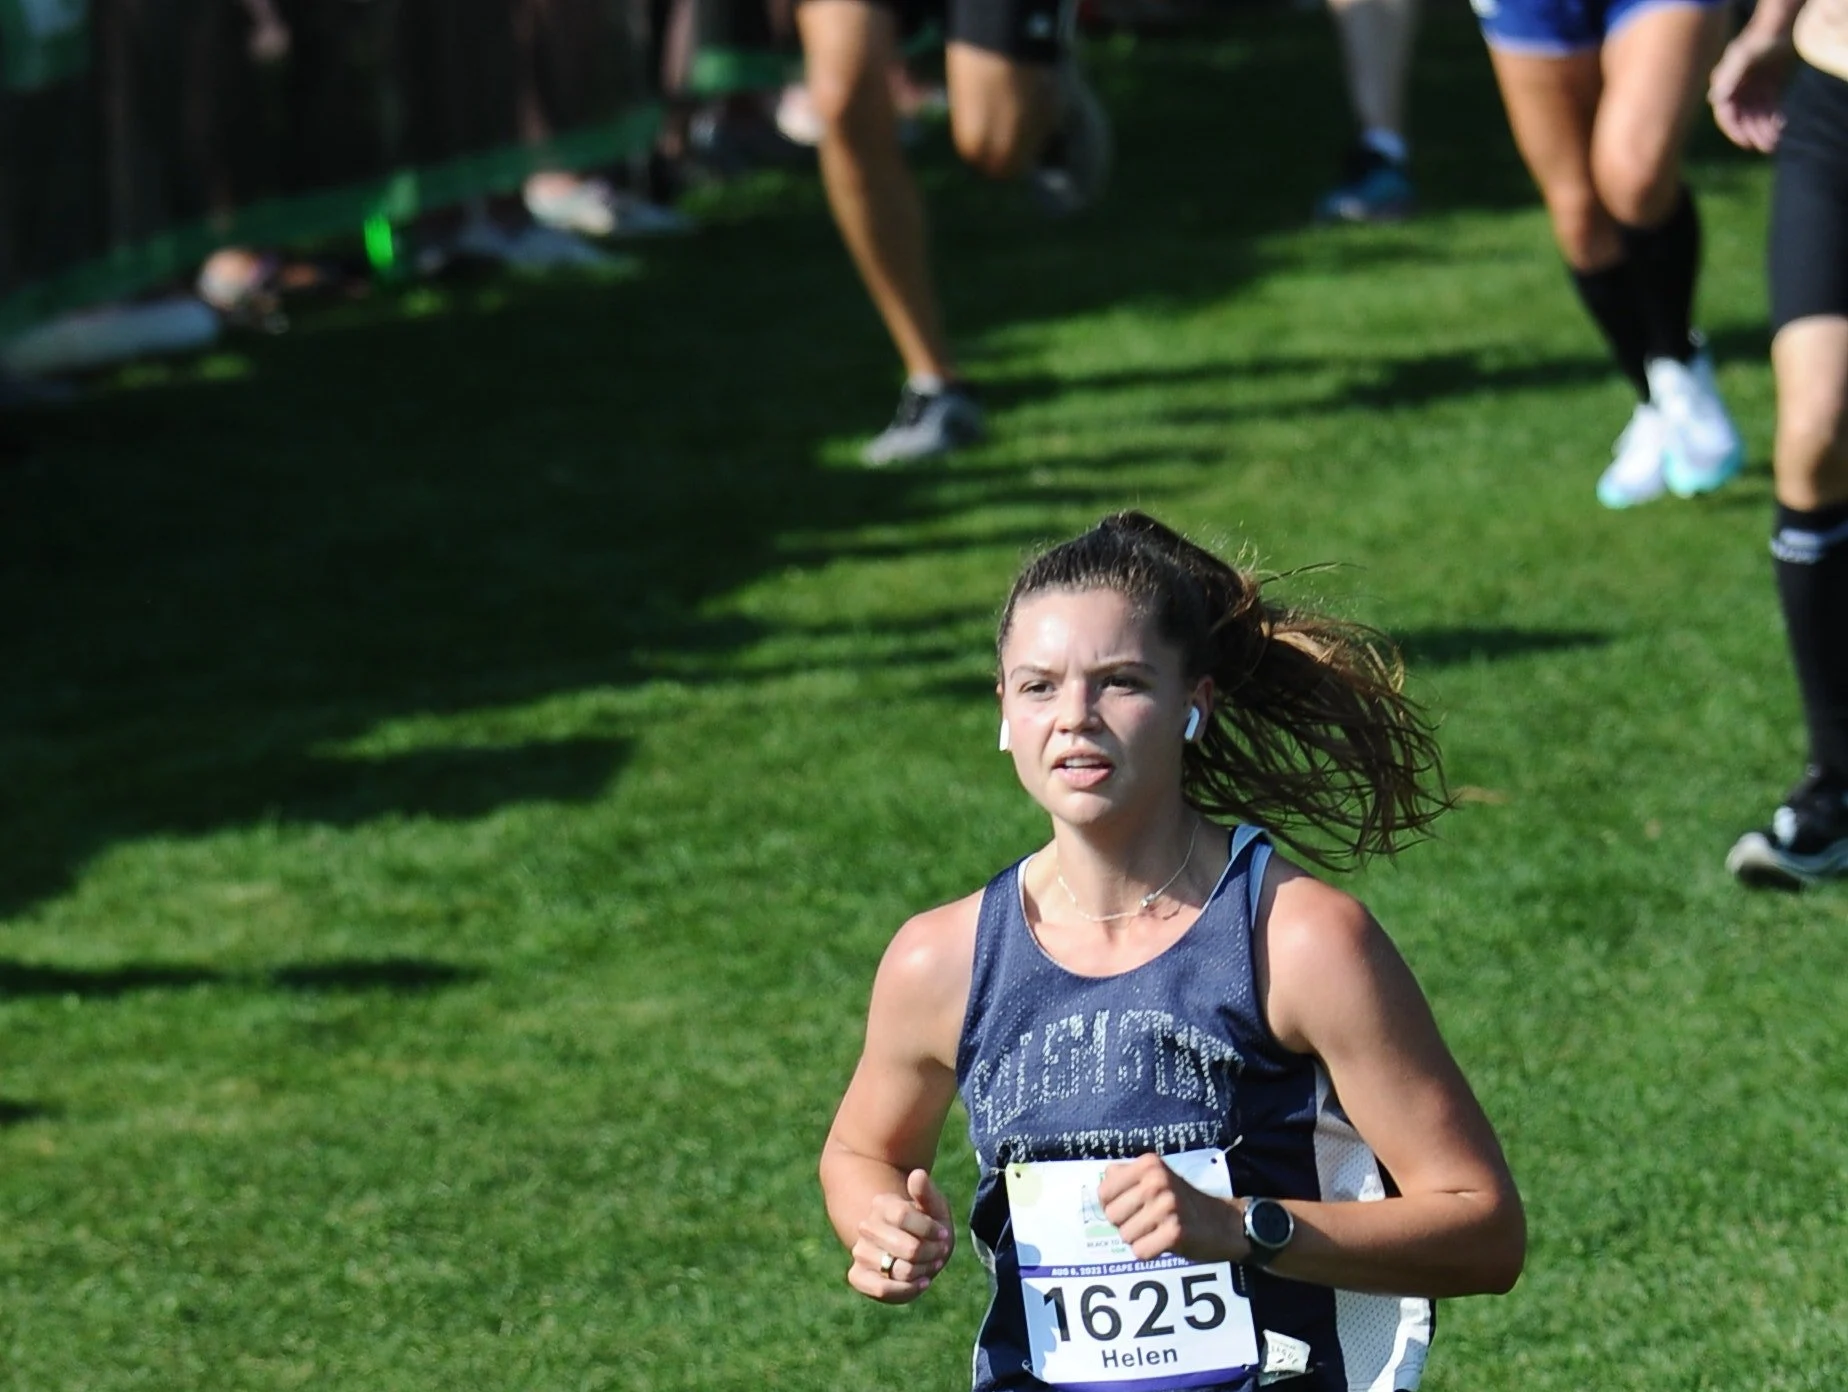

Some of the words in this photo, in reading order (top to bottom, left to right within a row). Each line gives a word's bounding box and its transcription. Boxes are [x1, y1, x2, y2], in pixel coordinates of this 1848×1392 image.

[1051, 1268, 1069, 1277] AUG
[1108, 1263, 1133, 1274] CAPE
[1134, 1257, 1189, 1271] ELIZABETH,
[1043, 1272, 1227, 1342] 1625
[1101, 1346, 1178, 1368] Helen
